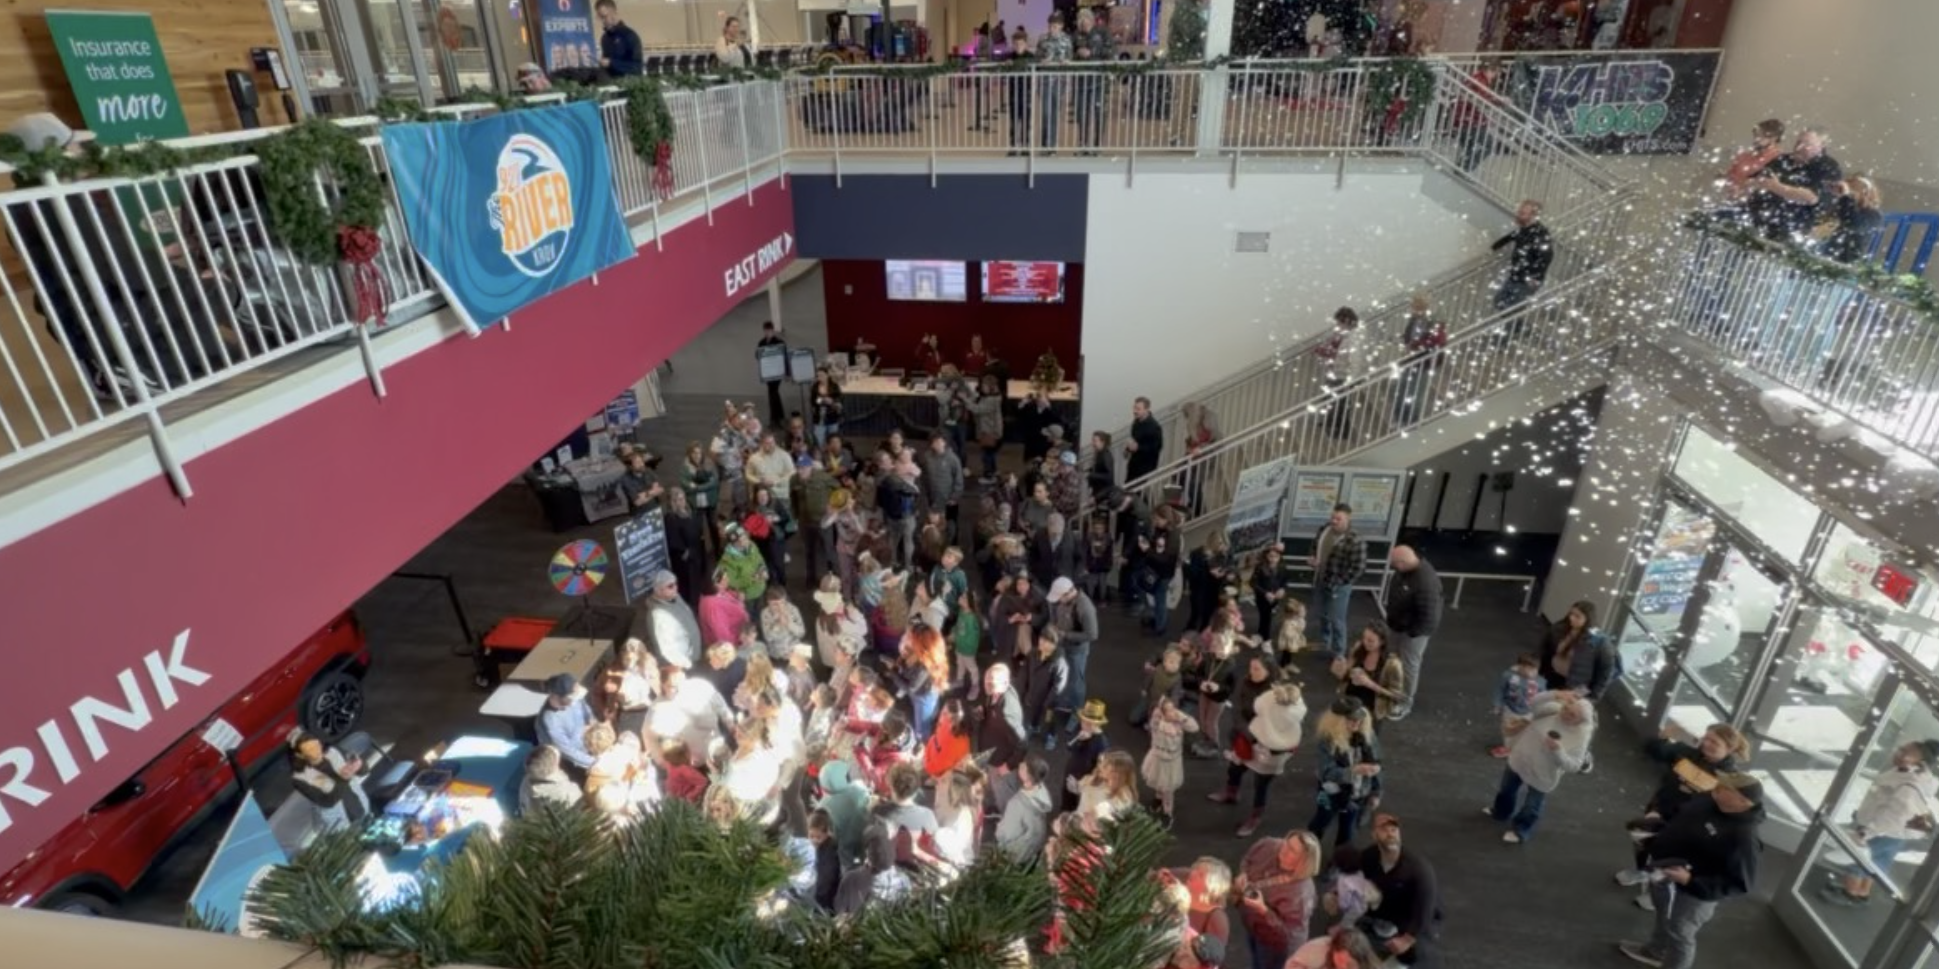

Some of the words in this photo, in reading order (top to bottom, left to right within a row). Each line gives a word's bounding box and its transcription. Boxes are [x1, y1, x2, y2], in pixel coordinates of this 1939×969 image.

[68, 37, 152, 57] Insurance
[86, 62, 118, 81] that
[120, 62, 154, 79] does
[97, 93, 167, 124] more
[500, 172, 572, 252] RIVER
[724, 252, 756, 298] EAST
[757, 235, 784, 274] RINK
[0, 627, 213, 834] RINK
